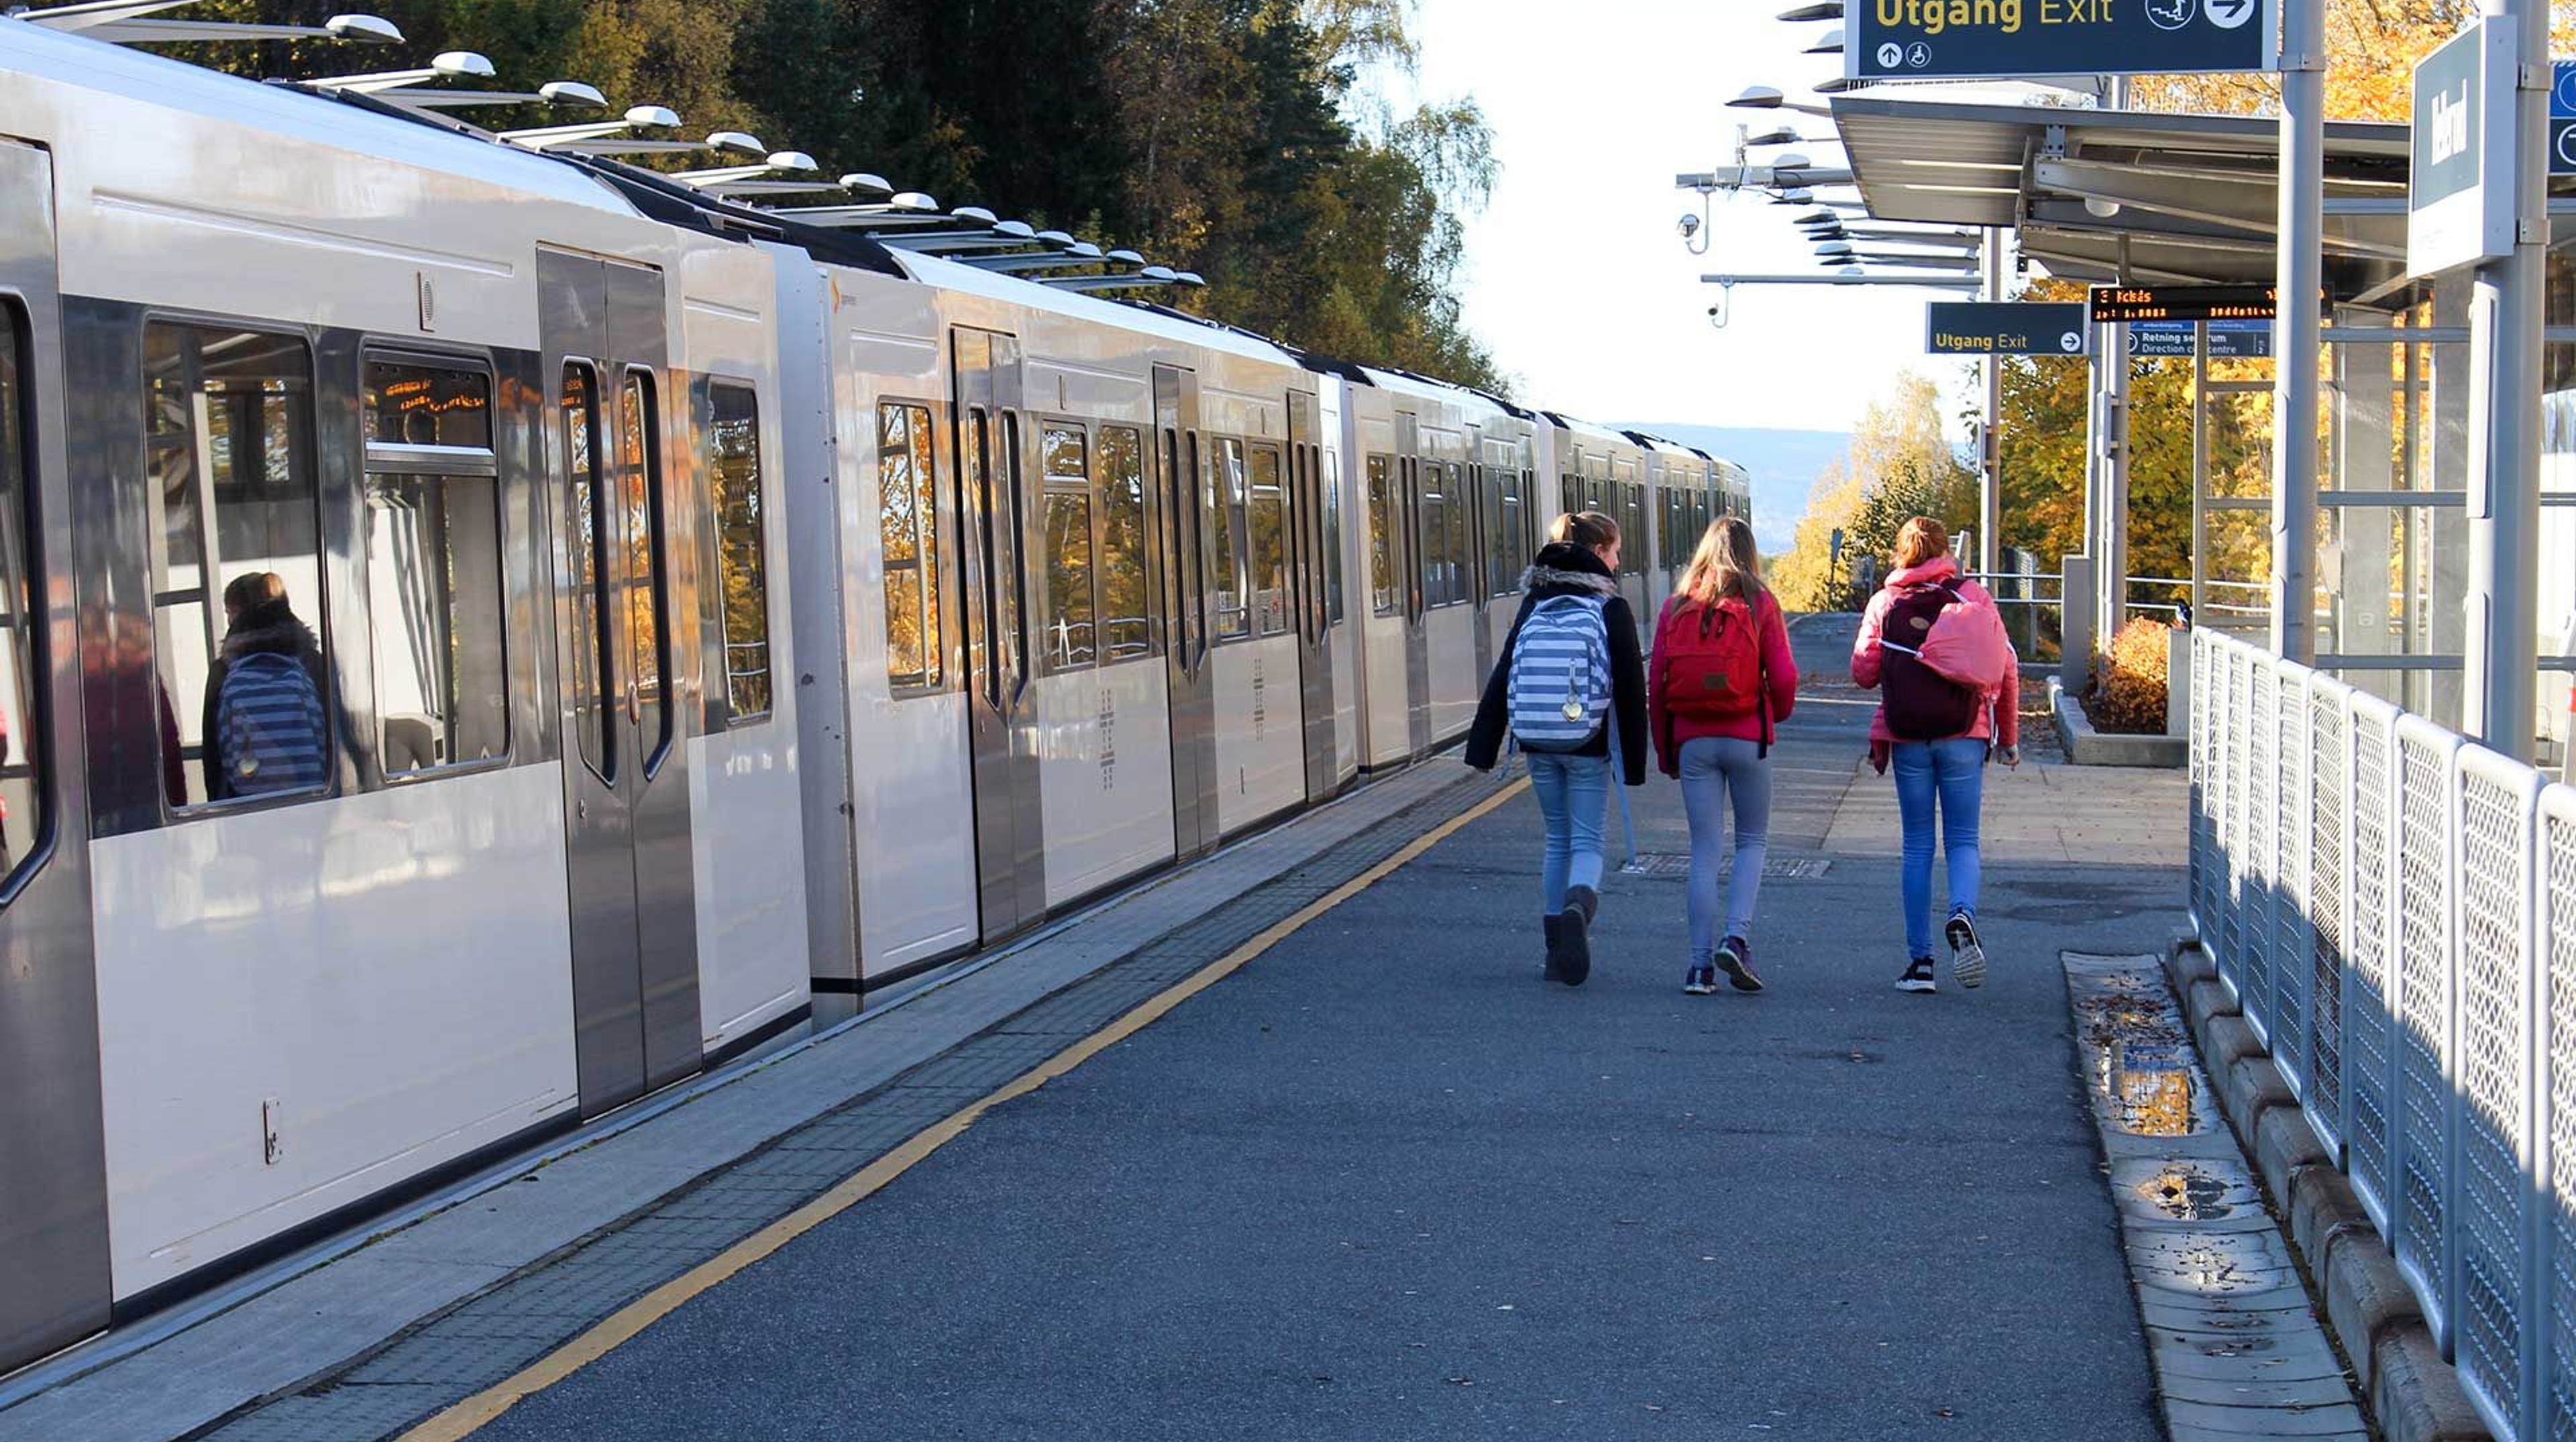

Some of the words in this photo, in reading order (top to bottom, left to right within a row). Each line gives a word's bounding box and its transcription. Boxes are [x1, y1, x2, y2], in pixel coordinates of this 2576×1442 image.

[1876, 0, 2023, 34] Utgang
[2040, 0, 2114, 23] Exit
[1936, 333, 1992, 351] Utgang
[1998, 333, 2027, 347] Exit
[2142, 333, 2180, 344] Retning
[2142, 344, 2185, 353] Direction
